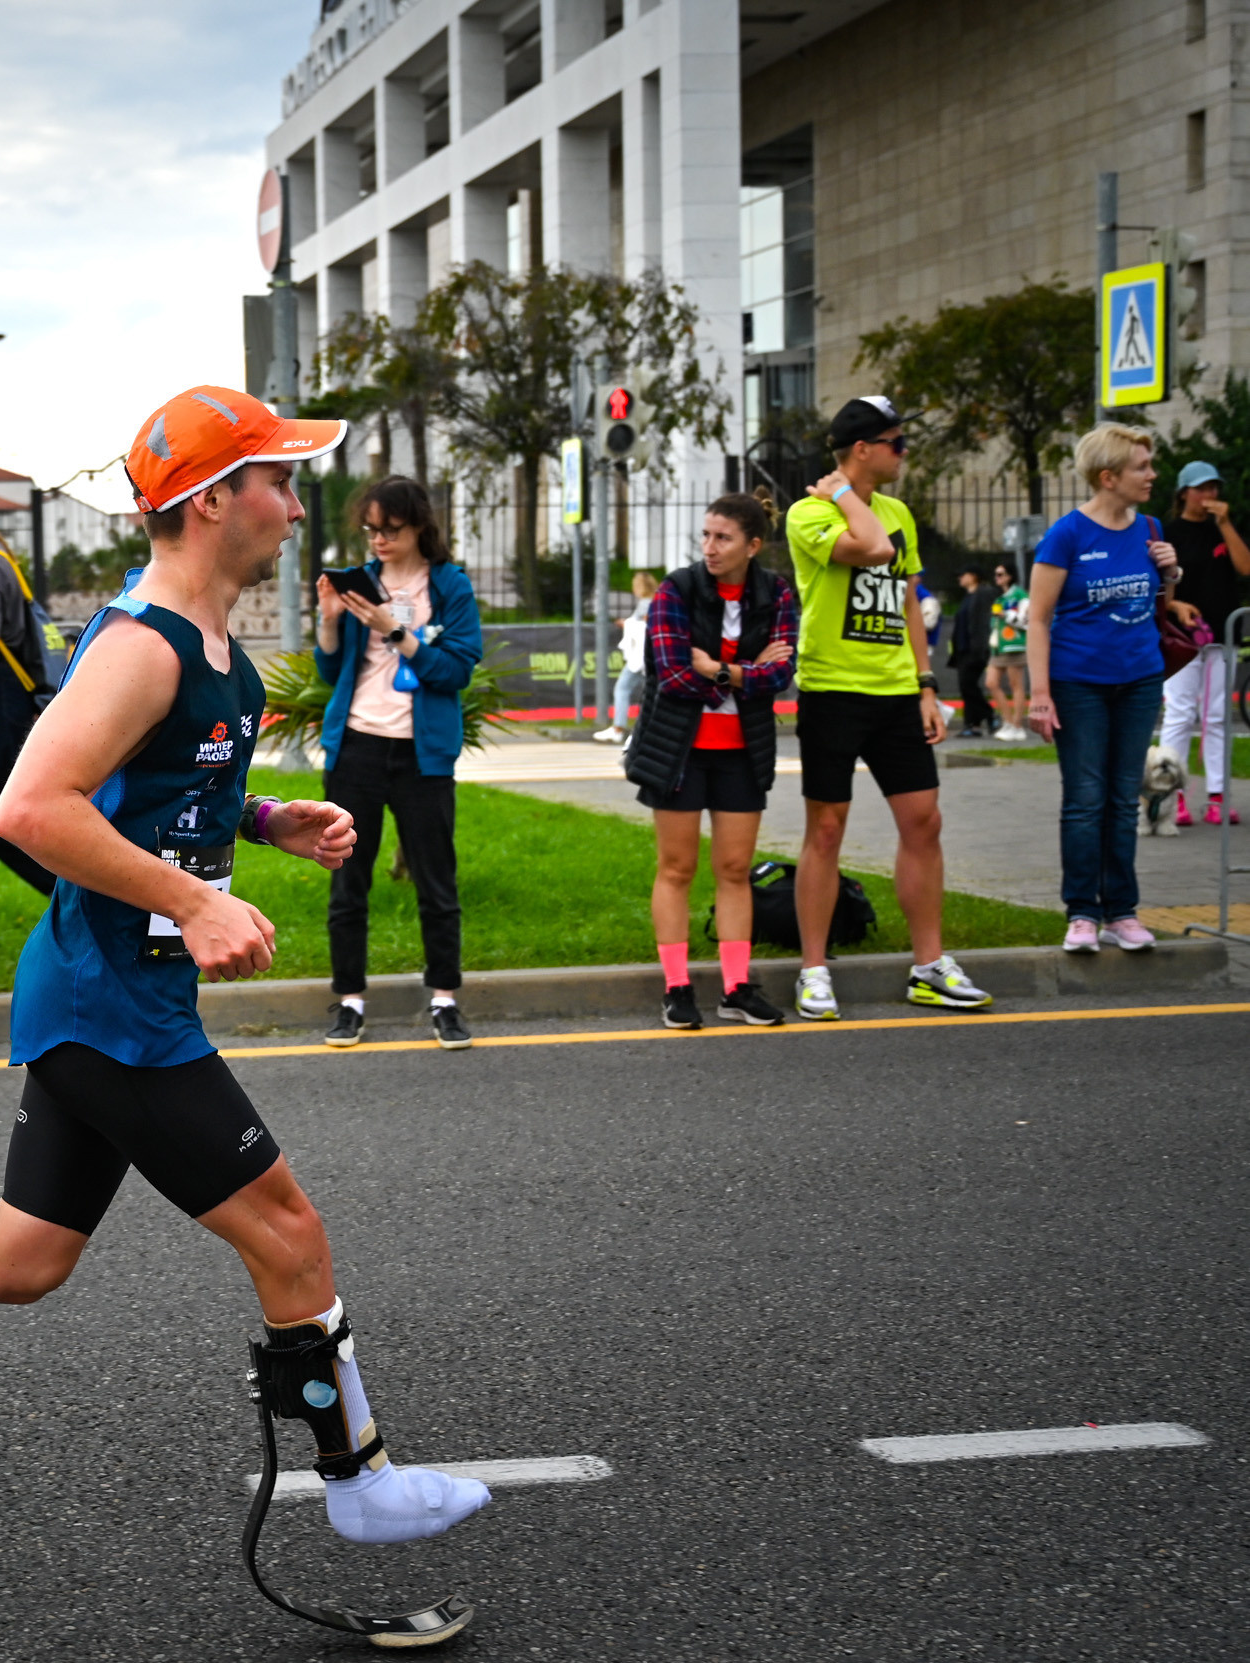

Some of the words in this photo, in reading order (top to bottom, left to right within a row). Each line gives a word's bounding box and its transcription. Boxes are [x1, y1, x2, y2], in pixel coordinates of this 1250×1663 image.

[282, 439, 313, 449] 2XU
[851, 614, 886, 633] 113
[529, 652, 568, 673] IRON
[199, 740, 234, 753] ИНТЕР
[161, 849, 175, 859] IRON
